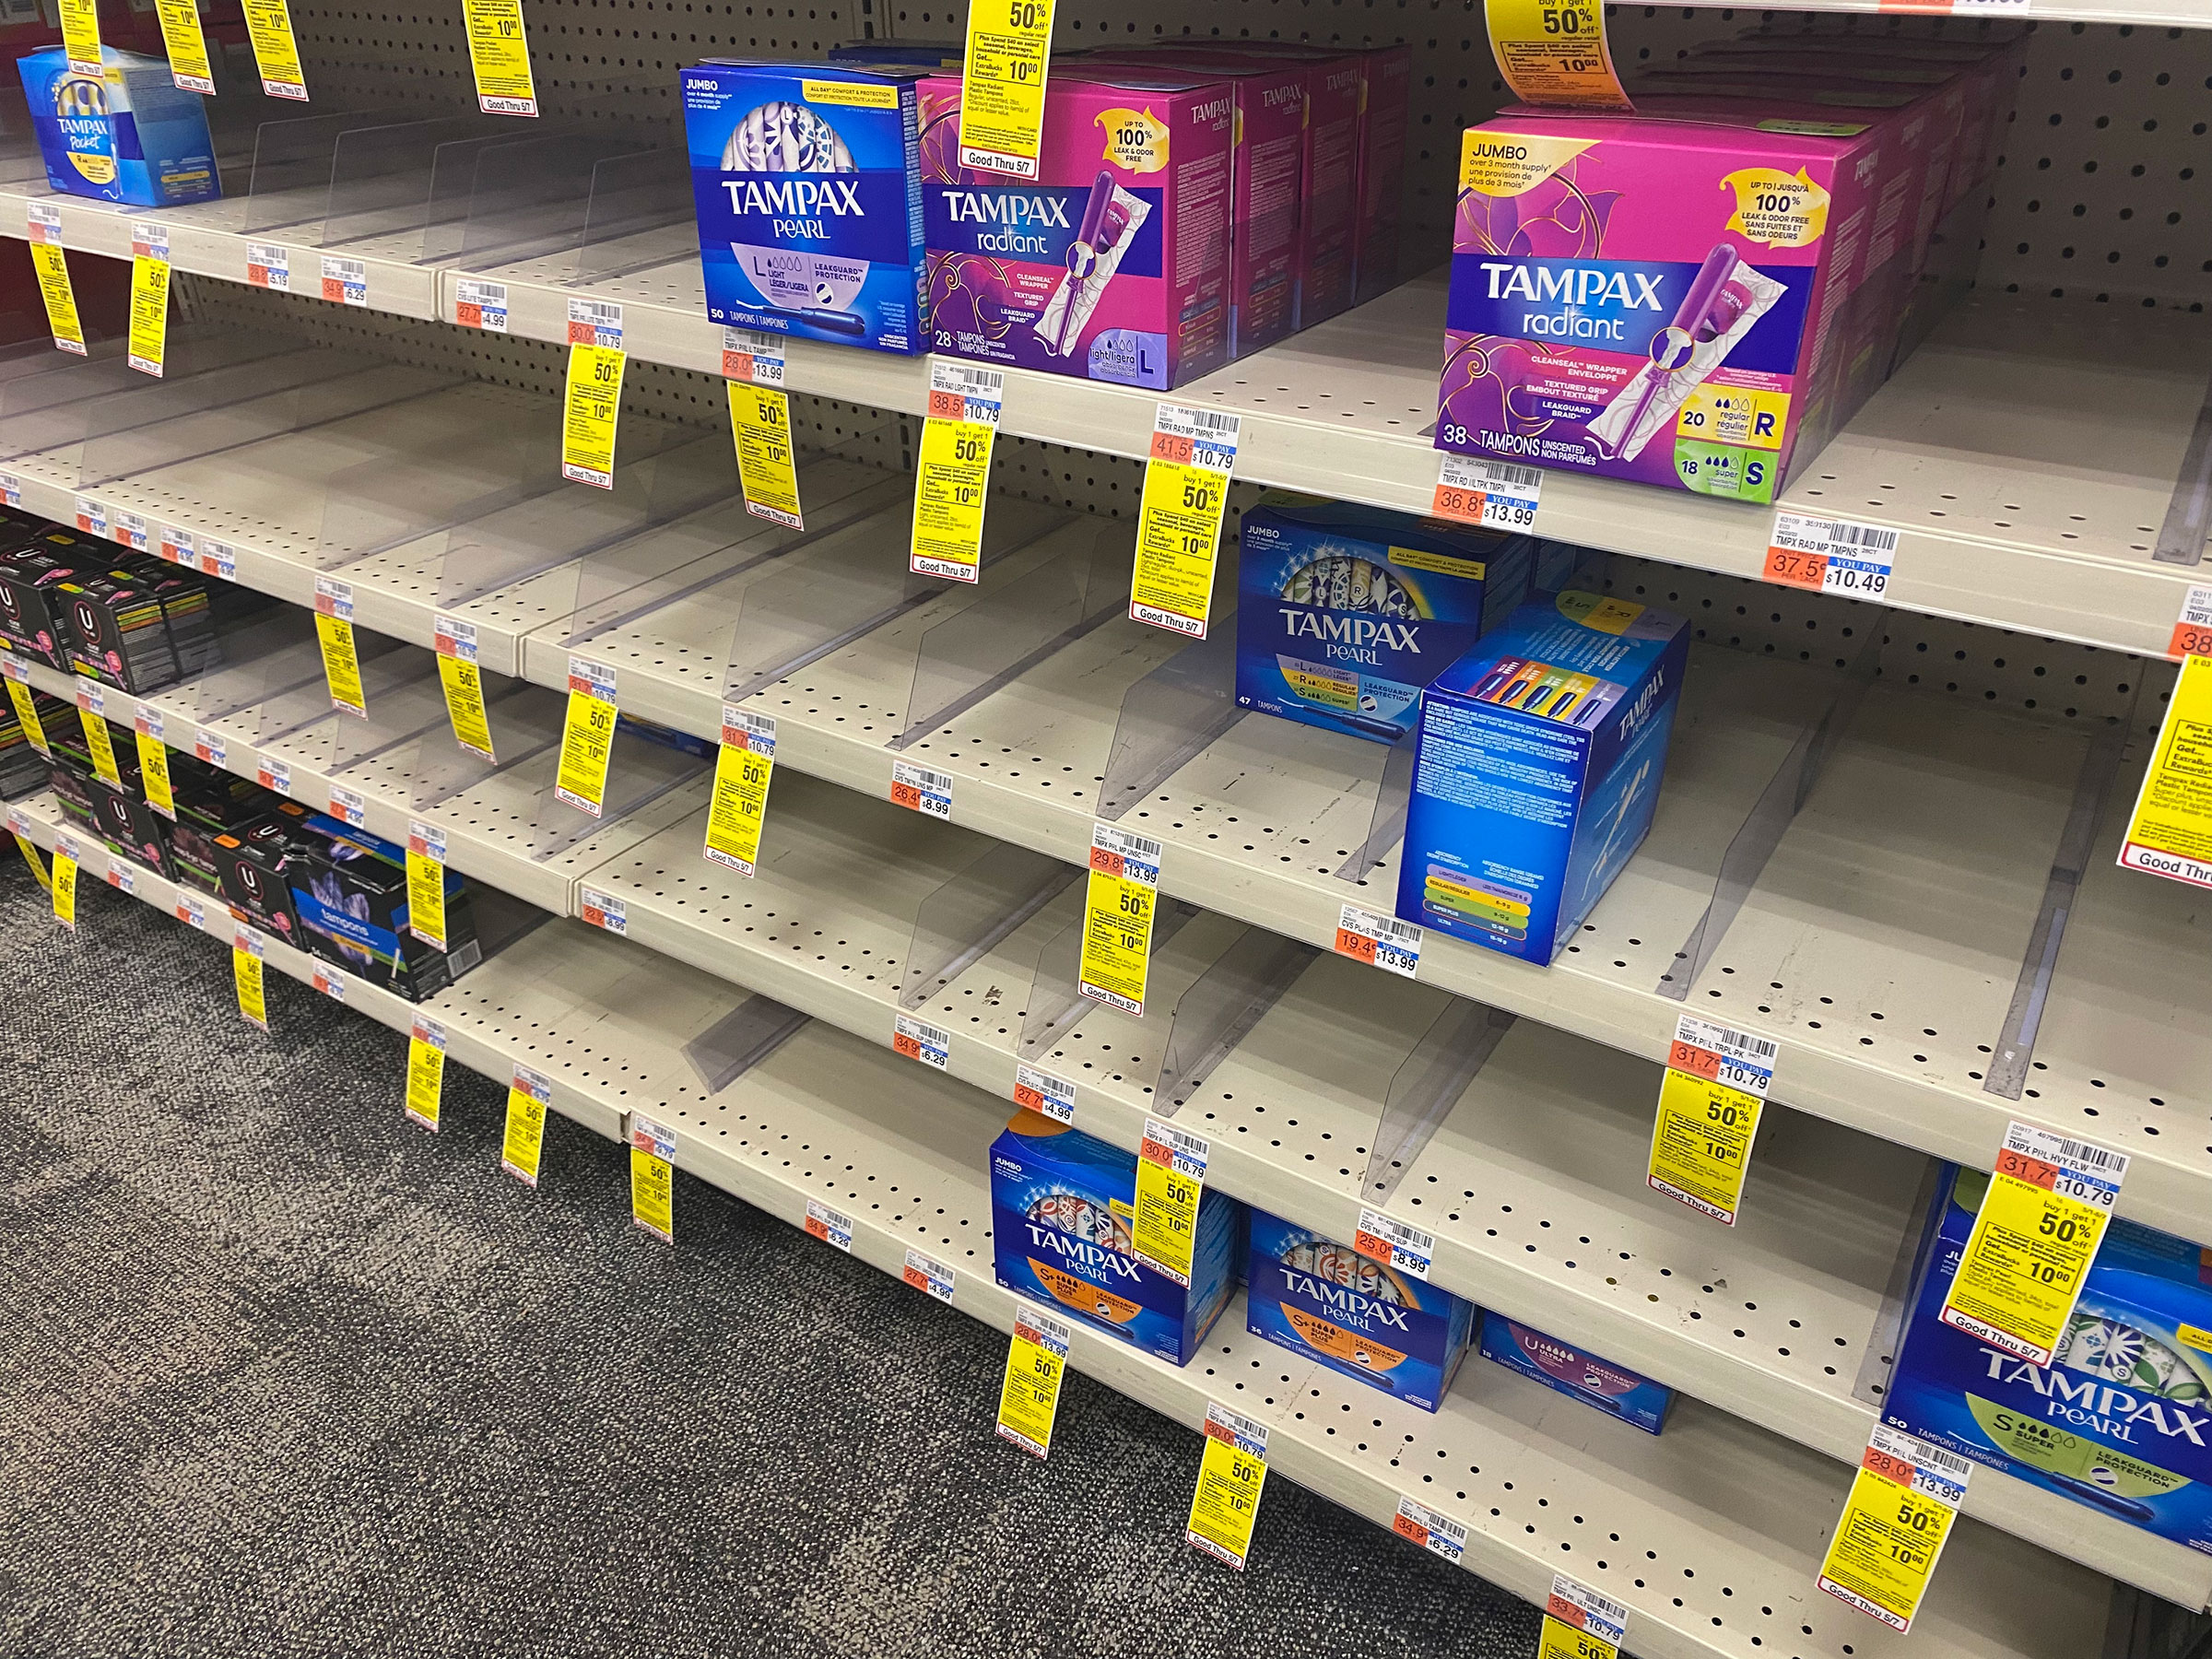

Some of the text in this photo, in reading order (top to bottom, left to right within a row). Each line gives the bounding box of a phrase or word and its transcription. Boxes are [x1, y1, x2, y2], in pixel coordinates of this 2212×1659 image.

[1009, 2, 1046, 29] 50%
[1543, 8, 1593, 33] 50%
[686, 79, 718, 91] JUMBO
[56, 118, 109, 136] TAMPAX
[1124, 120, 1134, 128] UP
[69, 133, 100, 150] Pocket
[1116, 128, 1153, 147] 100%
[1125, 154, 1142, 162] FREE
[1473, 144, 1526, 159] JUMBO
[969, 152, 1030, 173] Good Thru 5/7
[1485, 170, 1520, 179] provision
[721, 181, 865, 217] TAMPAX
[1756, 194, 1801, 212] 100%
[941, 191, 1071, 229] TAMPAX
[977, 226, 1048, 254] radiant
[1768, 231, 1798, 240] ODEURS
[753, 256, 766, 276] L
[768, 270, 785, 279] LIGHT
[770, 278, 809, 293] LÉGER/LIGERA
[815, 271, 861, 283] PROTECTION
[1019, 280, 1048, 289] WRAPPER
[1480, 262, 1665, 312] TAMPAX
[1014, 291, 1043, 302] TEXTURED
[711, 308, 724, 319] 50
[730, 311, 789, 330] TAMPONS TAMPONES
[1000, 308, 1035, 320] LEAKGUARD
[1522, 309, 1625, 341] radiant
[935, 329, 952, 347] 28
[956, 330, 985, 345] TAMPONS
[1089, 347, 1136, 363] light/ligera
[1568, 369, 1618, 382] ENVELOPPE
[1526, 384, 1599, 402] EMBOUT TEXTURÉ
[1545, 380, 1608, 394] TEXTURED GRIP
[965, 405, 999, 422] $10.79
[1542, 401, 1592, 415] LEAKGUARD
[1720, 411, 1750, 421] regular
[1683, 411, 1705, 426] 20
[1755, 412, 1775, 437] R
[1158, 421, 1172, 432] TMPX
[1186, 427, 1194, 435] MP
[1194, 429, 1214, 440] TMPNS
[1442, 424, 1467, 445] 38
[1199, 441, 1231, 453] YOU PAY
[1480, 429, 1540, 457] TAMPONS
[1542, 441, 1585, 454] UNSCENTED
[1541, 451, 1597, 465] NON PARFUMÉS
[1682, 461, 1698, 475] 18
[1715, 468, 1738, 478] super
[1746, 462, 1764, 485] S
[1182, 486, 1218, 512] 50%
[1441, 491, 1485, 512] 36.8¢
[1493, 496, 1530, 508] YOU PAY
[1247, 525, 1280, 538] JUMBO
[920, 560, 971, 578] Good Thru 5/7
[1773, 555, 1827, 577] 37.5¢
[1836, 559, 1882, 573] YOU PAY
[1826, 569, 1886, 593] $10.49
[79, 607, 93, 629] U
[2185, 611, 2209, 626] TMPX
[1278, 608, 1421, 653] TAMPAX
[1300, 661, 1306, 671] L
[1300, 675, 1307, 684] R
[1239, 696, 1251, 705] 47
[1300, 688, 1306, 697] S
[1364, 688, 1410, 702] PROTECTION
[1619, 664, 1665, 742] TAMPAX
[2156, 780, 2181, 792] Plastic
[2159, 772, 2188, 787] Tampax
[112, 799, 127, 822] U
[923, 799, 948, 815] $8.99
[2149, 801, 2169, 813] equal
[2139, 852, 2182, 874] Good
[243, 865, 257, 888] U
[1124, 865, 1157, 884] $13.99
[321, 908, 369, 935] tampons
[1342, 920, 1354, 929] CVS
[1371, 929, 1383, 938] TMP
[1376, 950, 1416, 971] $13.99
[1087, 987, 1136, 1011] Good Thru 5/7
[922, 1051, 945, 1066] $6.29
[1719, 1065, 1768, 1090] $10.79
[1044, 1103, 1071, 1120] $4.99
[1706, 1100, 1749, 1126] 50%
[995, 1157, 1022, 1172] JUMBO
[2055, 1179, 2113, 1206] $10.79
[1360, 1222, 1407, 1245] CVS UNS SUP
[2039, 1212, 2091, 1243] 50%
[1025, 1224, 1142, 1283] TAMPAX
[1394, 1253, 1425, 1273] $8.99
[997, 1278, 1008, 1288] 50
[1040, 1268, 1054, 1281] S+
[1056, 1281, 1077, 1293] SUPER
[1056, 1287, 1073, 1297] PLUS
[1278, 1268, 1409, 1332] TAMPAX
[1292, 1314, 1310, 1327] S+
[1311, 1333, 1328, 1343] PLUS
[1312, 1328, 1334, 1340] SUPER
[1524, 1336, 1538, 1350] U
[1955, 1316, 2041, 1359] Good Thru 5/7
[1482, 1349, 1492, 1359] 18
[1539, 1349, 1564, 1363] ULTRA
[1586, 1367, 1630, 1388] PROTECTION
[1979, 1347, 2210, 1447] TAMPAX
[1888, 1416, 1908, 1429] 50
[1994, 1414, 2015, 1432] S
[2016, 1430, 2055, 1450] SUPER
[1872, 1439, 1938, 1471] TMPX UNSCNT
[1917, 1428, 2010, 1471] TAMPONS TAMPONES
[2096, 1456, 2170, 1488] PROTECTION
[1897, 1505, 1941, 1532] 50%
[1429, 1538, 1458, 1559] $6.29
[1829, 1584, 1900, 1626] Good Thru 5/7
